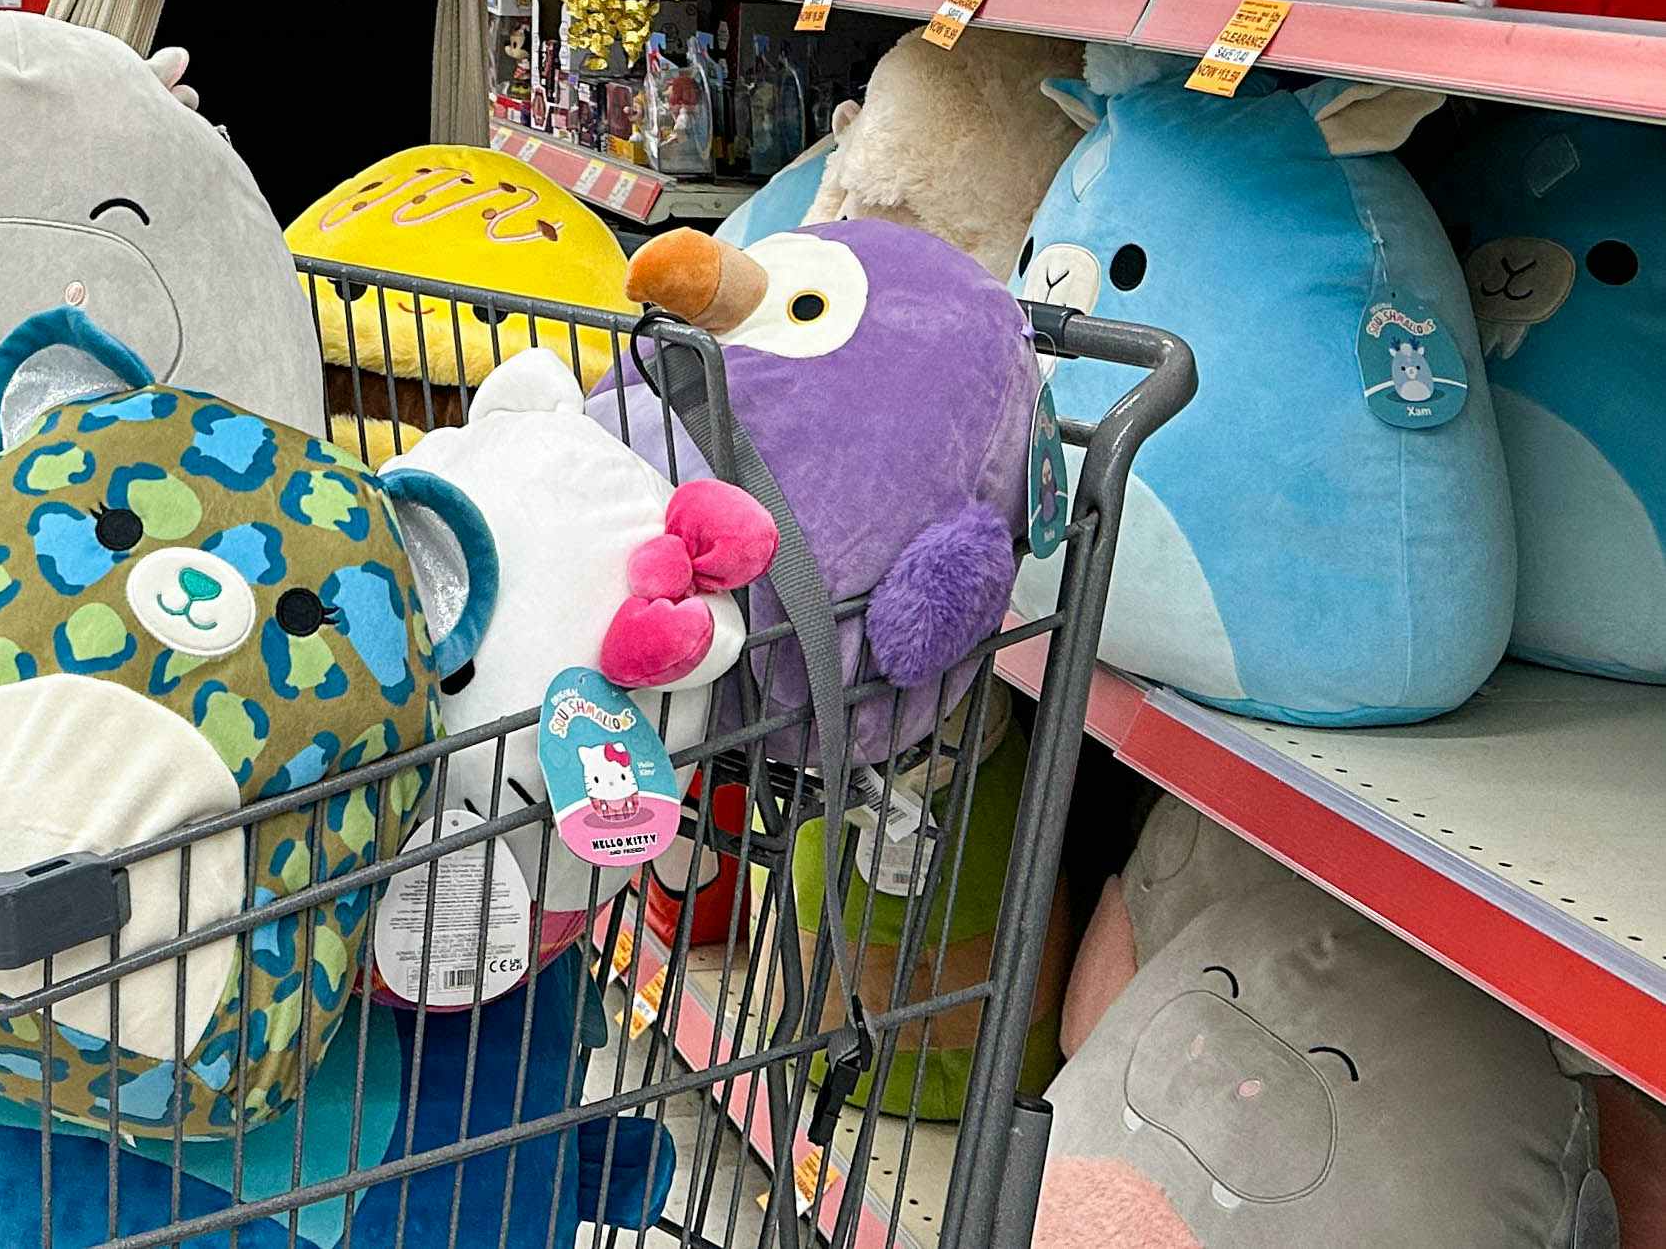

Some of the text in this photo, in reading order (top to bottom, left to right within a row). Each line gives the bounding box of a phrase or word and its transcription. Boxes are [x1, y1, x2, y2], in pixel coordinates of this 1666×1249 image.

[1219, 30, 1268, 48] CLEARANCE
[1406, 406, 1432, 416] Xam
[592, 834, 657, 851] HELLO KITTY
